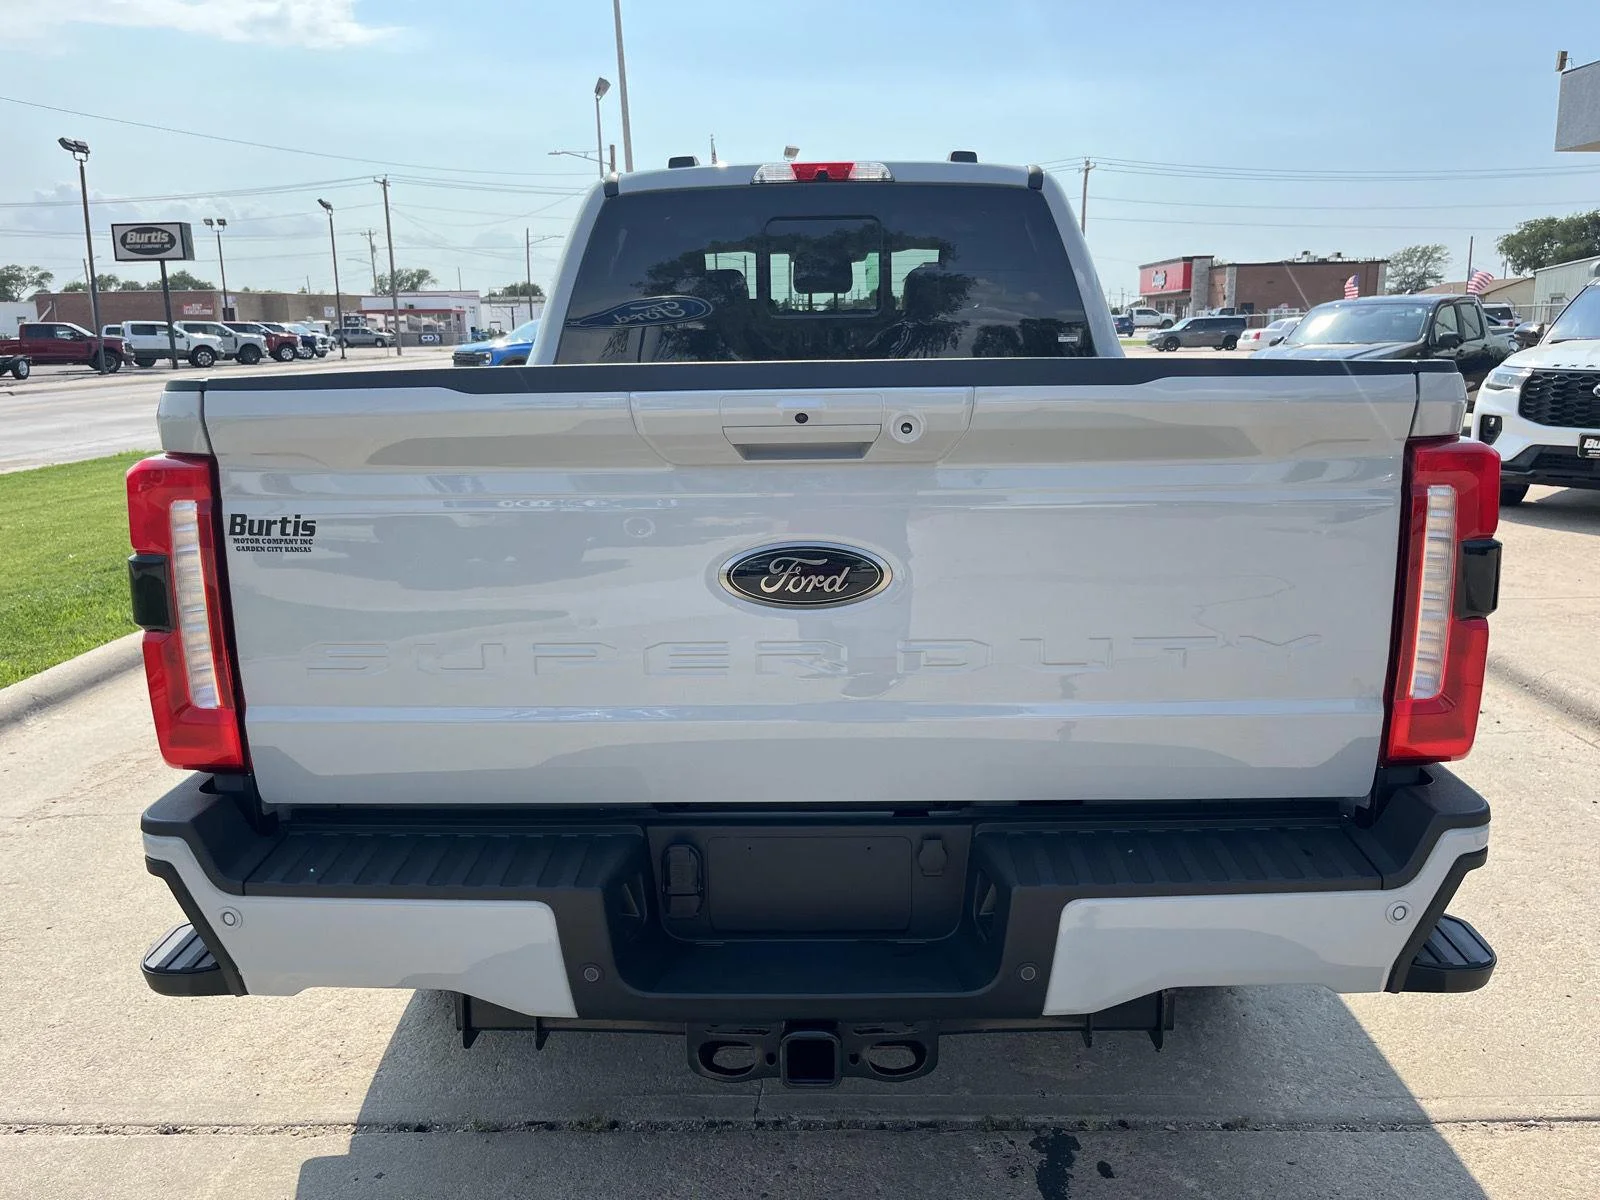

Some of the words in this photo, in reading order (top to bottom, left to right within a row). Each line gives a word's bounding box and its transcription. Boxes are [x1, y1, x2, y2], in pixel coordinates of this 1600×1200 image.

[126, 231, 170, 244] Burtis
[229, 513, 317, 537] Burtis
[233, 537, 260, 545] MOTOR
[760, 556, 851, 594] Ford
[303, 639, 849, 678] SUPER
[896, 633, 1323, 675] DUTY
